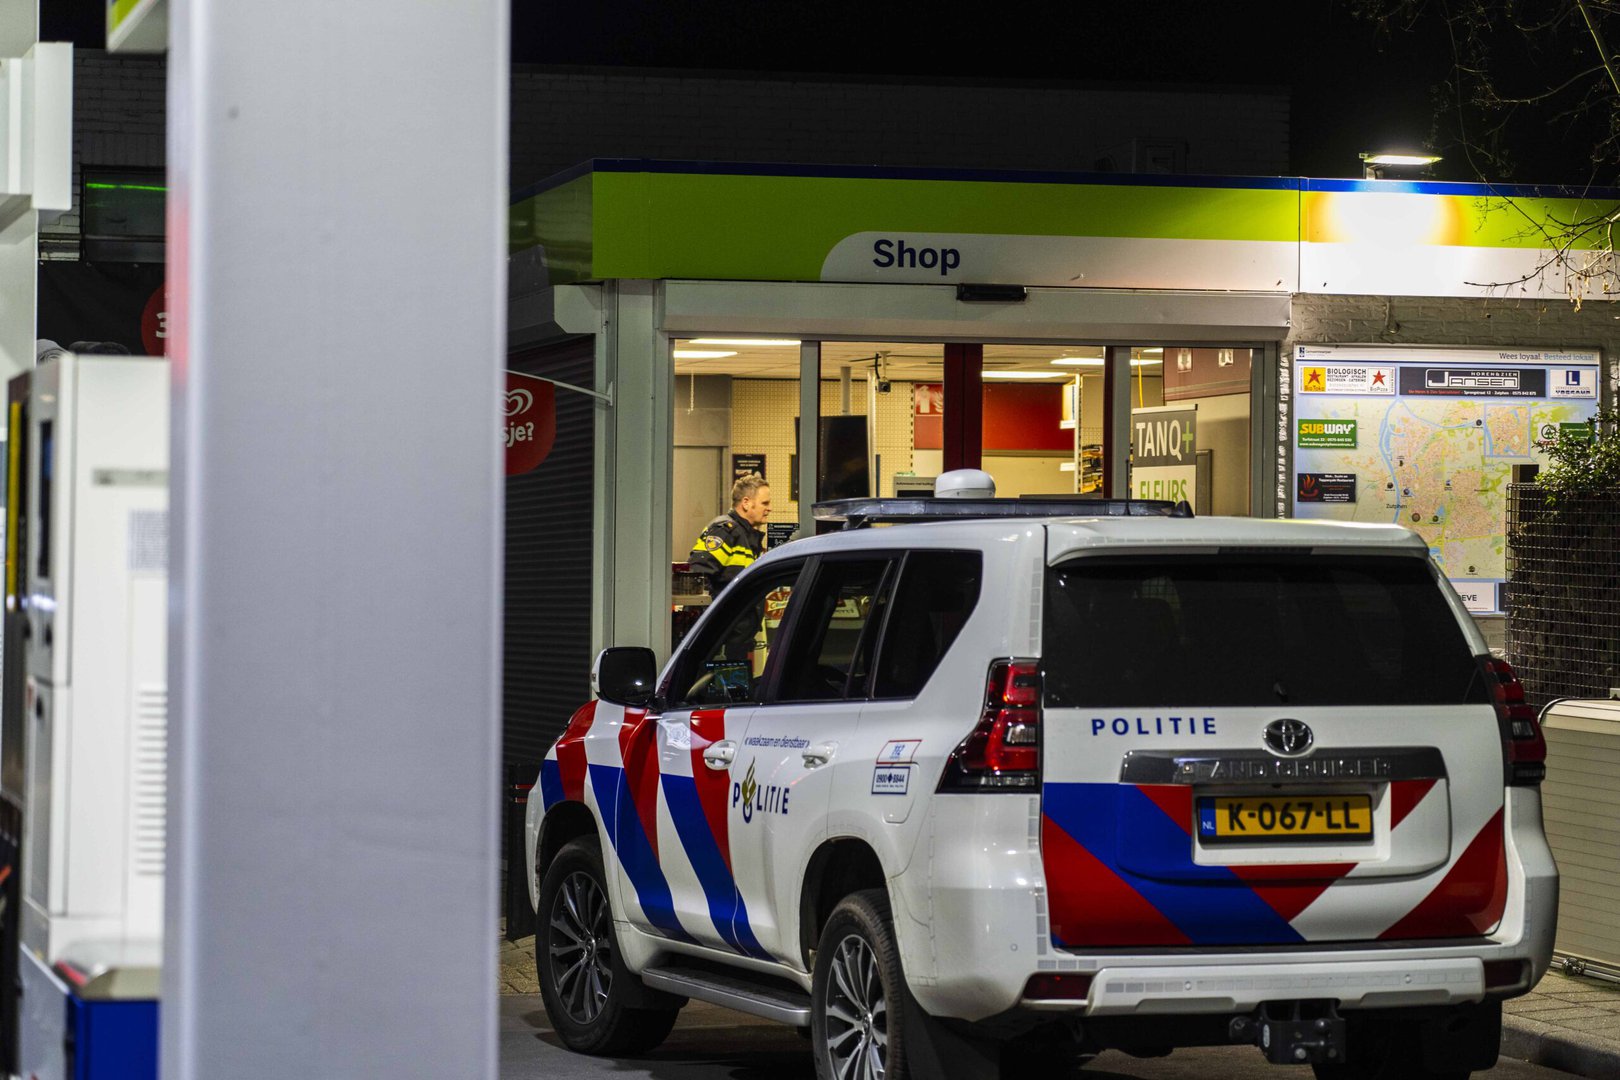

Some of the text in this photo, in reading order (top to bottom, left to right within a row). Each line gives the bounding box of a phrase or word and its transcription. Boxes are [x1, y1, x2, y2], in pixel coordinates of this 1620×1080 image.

[872, 239, 960, 276] Shop
[1136, 420, 1194, 462] TANQ+
[1299, 424, 1354, 434] SUBWAY
[1091, 718, 1216, 736] POLITIE
[1276, 758, 1393, 778] CRUISER
[733, 782, 790, 824] POLITIE
[1203, 822, 1214, 830] NL
[1228, 802, 1360, 832] K-067-LL
